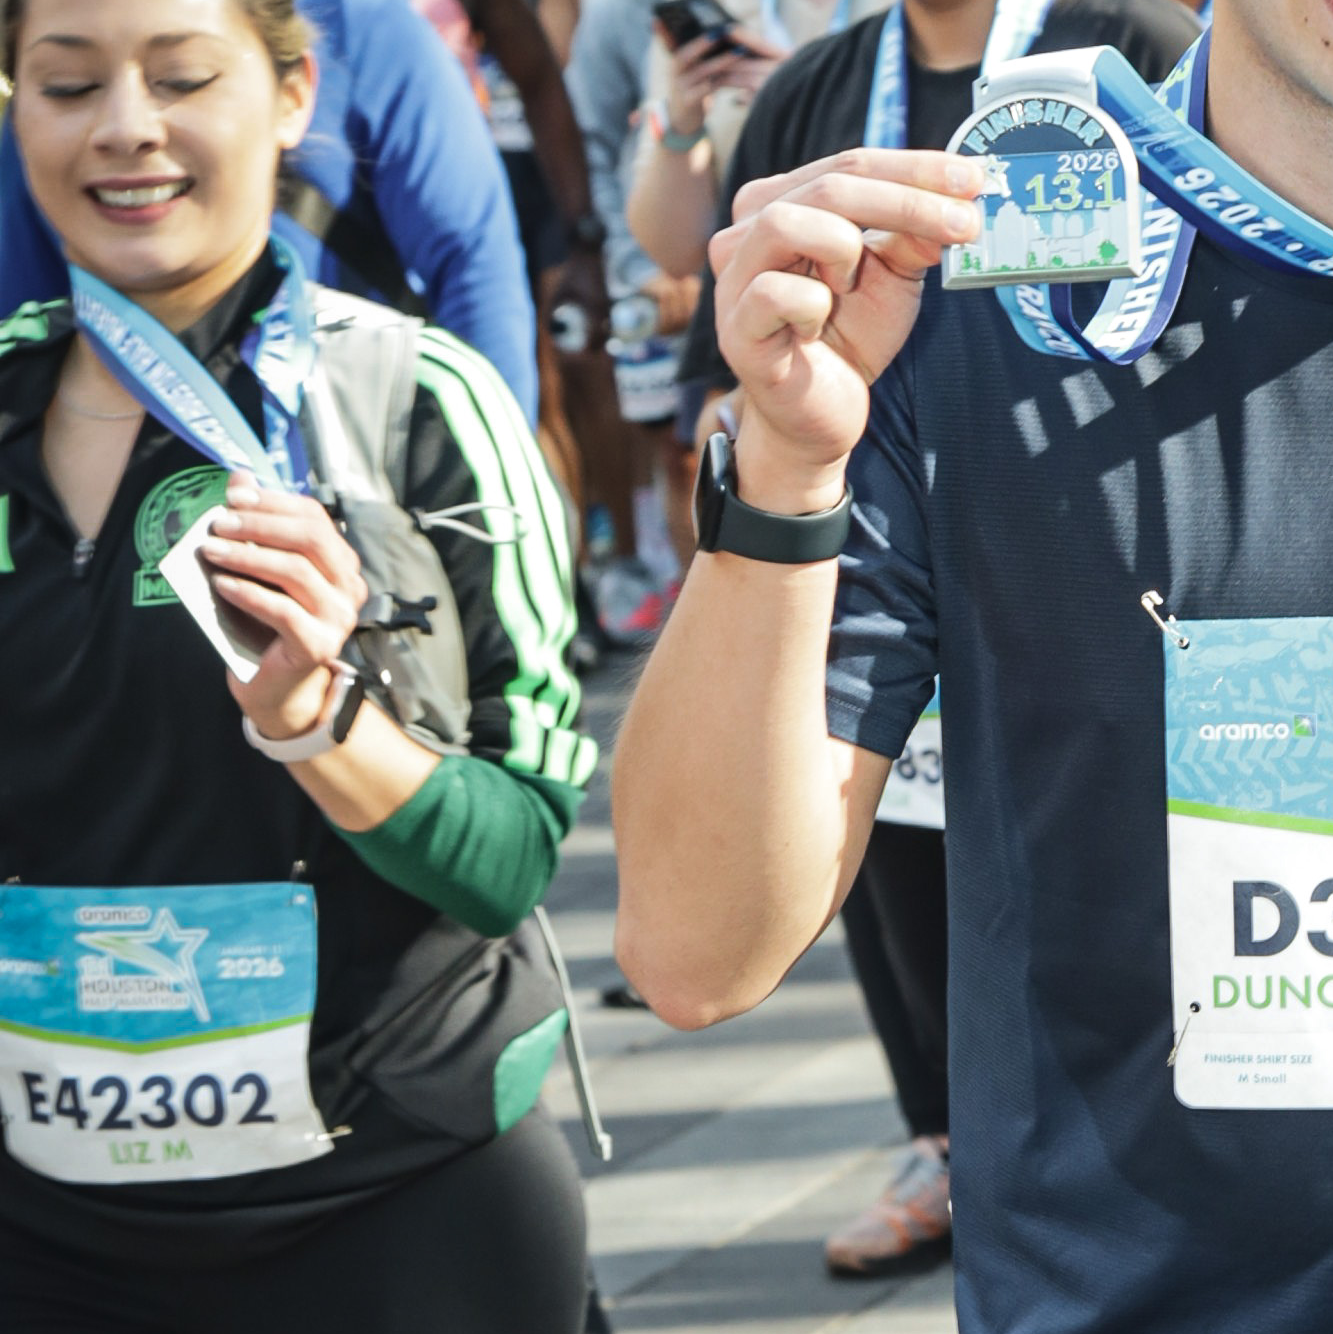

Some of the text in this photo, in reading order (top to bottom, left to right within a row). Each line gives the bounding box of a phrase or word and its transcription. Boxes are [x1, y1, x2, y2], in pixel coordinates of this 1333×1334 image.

[962, 99, 1104, 154] FINISHER
[1057, 151, 1119, 173] 2026
[1025, 170, 1122, 212] 13.1
[1093, 194, 1179, 354] NISHER
[1200, 723, 1290, 740] aramco
[217, 958, 284, 978] 2026
[1204, 1054, 1312, 1065] FINISHER SHIRT SIZE
[21, 1071, 277, 1131] E42302
[109, 1139, 194, 1165] LIZ M
